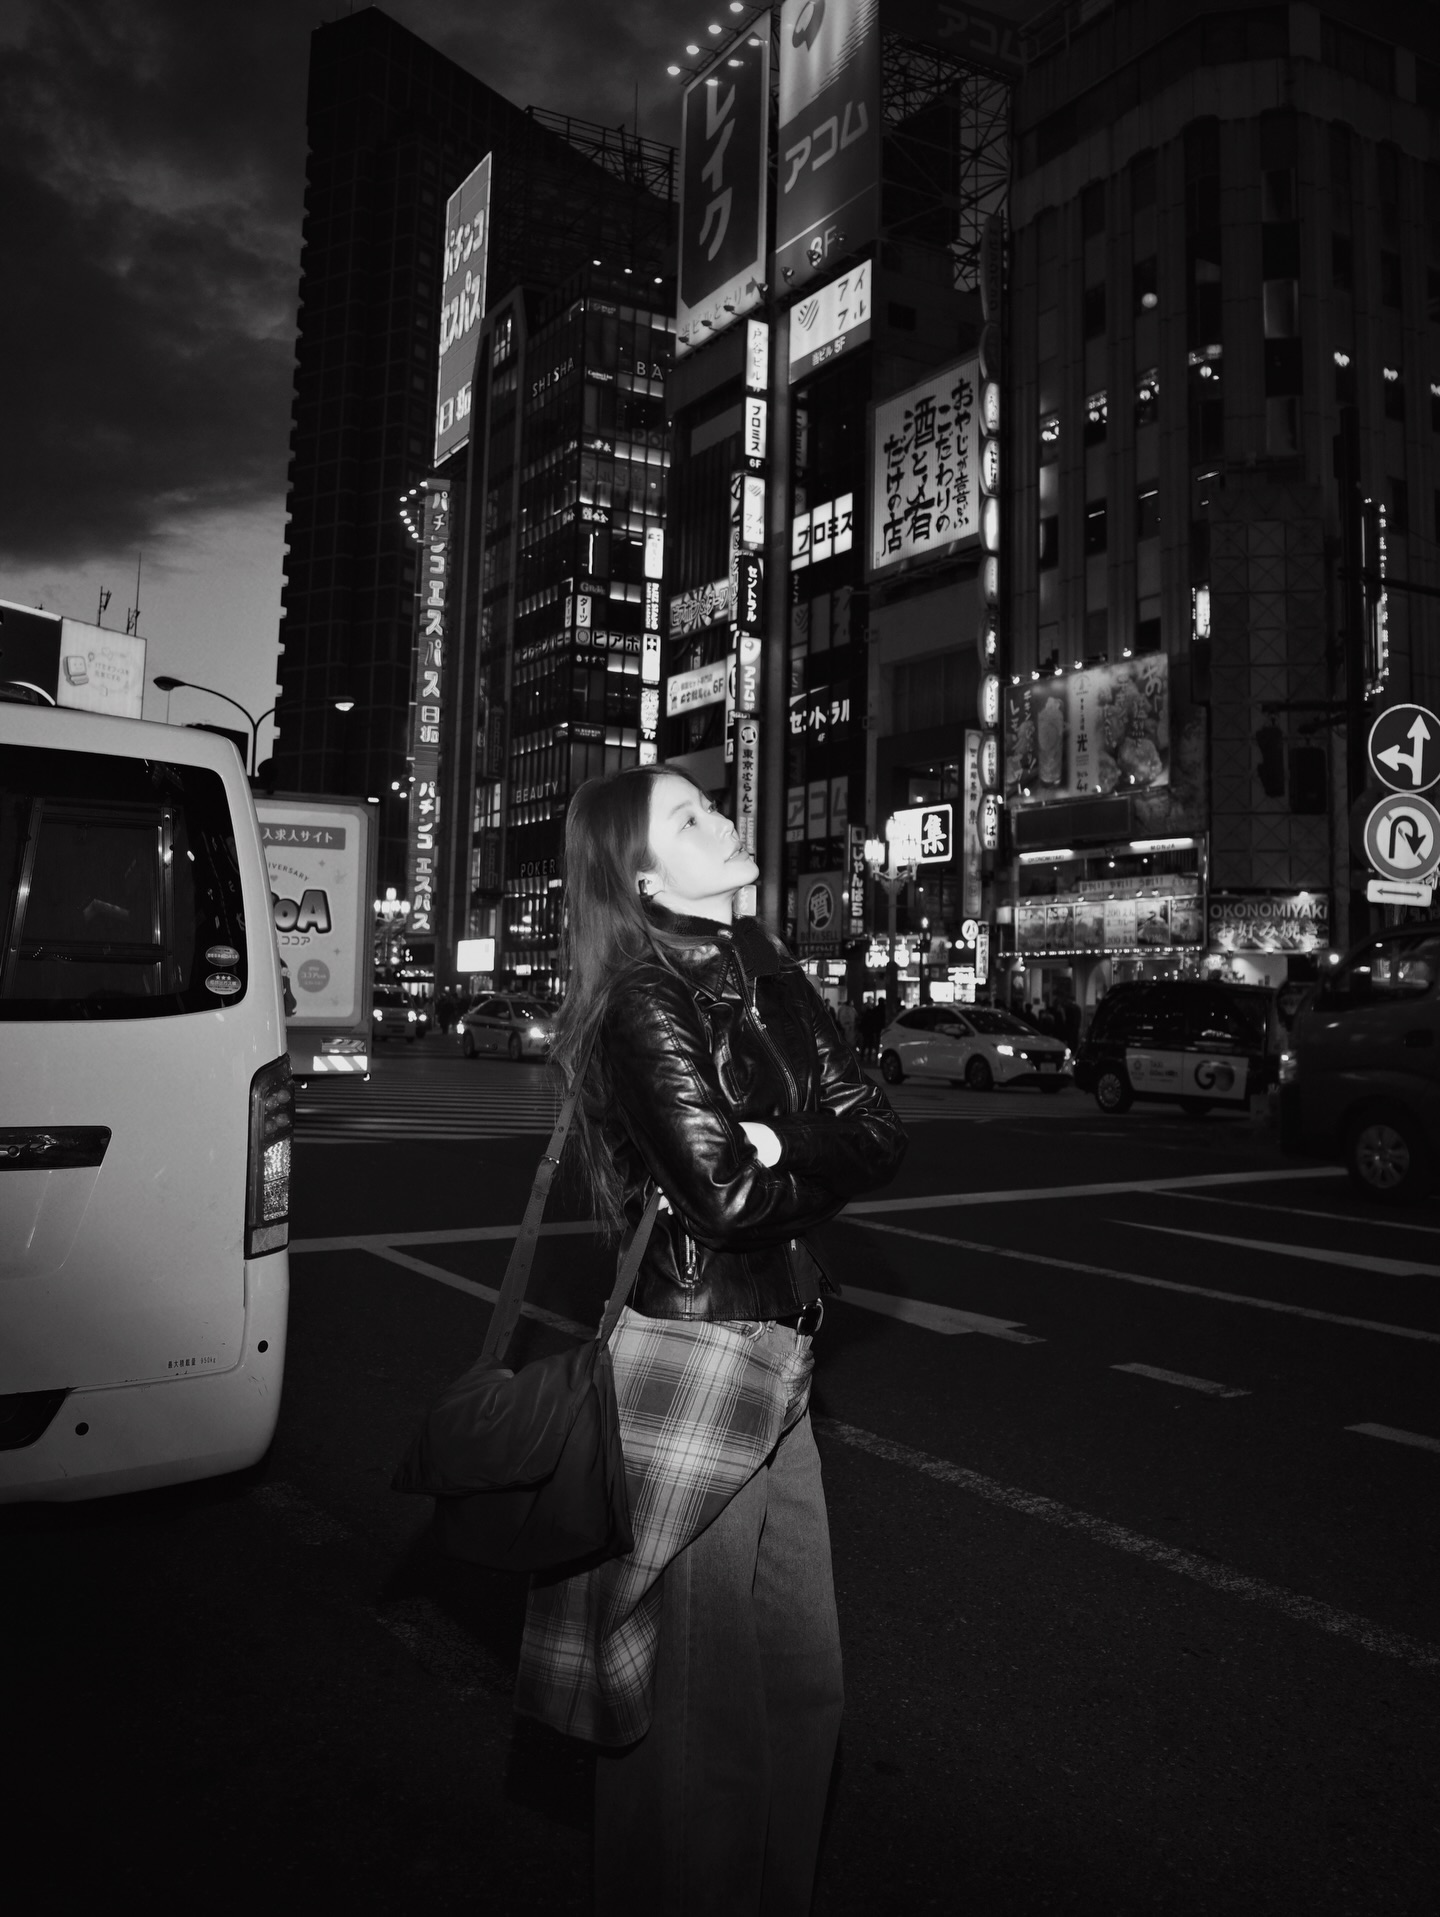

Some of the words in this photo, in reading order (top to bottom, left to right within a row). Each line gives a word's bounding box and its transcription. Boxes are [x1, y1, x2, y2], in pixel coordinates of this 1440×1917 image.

[700, 77, 735, 262] レイク
[784, 100, 869, 194] アコム
[443, 209, 486, 284] パチンコ
[438, 270, 481, 355] エスパス
[753, 328, 763, 381] 戸谷ビル
[532, 357, 575, 398] SHISHA
[751, 404, 762, 452] プロミス
[749, 458, 762, 468] 6F
[904, 395, 937, 543] 酒と肴
[935, 404, 954, 533] こだわりの
[952, 378, 974, 530] おやじが喜ぶ
[881, 434, 906, 556] だけの店
[798, 511, 853, 552] プロミス
[580, 597, 588, 623] ダーツ
[747, 565, 758, 622] セントラル
[713, 677, 724, 694] 6F
[516, 781, 558, 803] BEAUTY
[263, 827, 334, 844] 入求人サイト
[922, 814, 946, 854] 集
[520, 859, 556, 877] POKER
[271, 889, 332, 934] oA
[1209, 902, 1328, 919] OKONOMIYAKI
[282, 936, 311, 946] ココア
